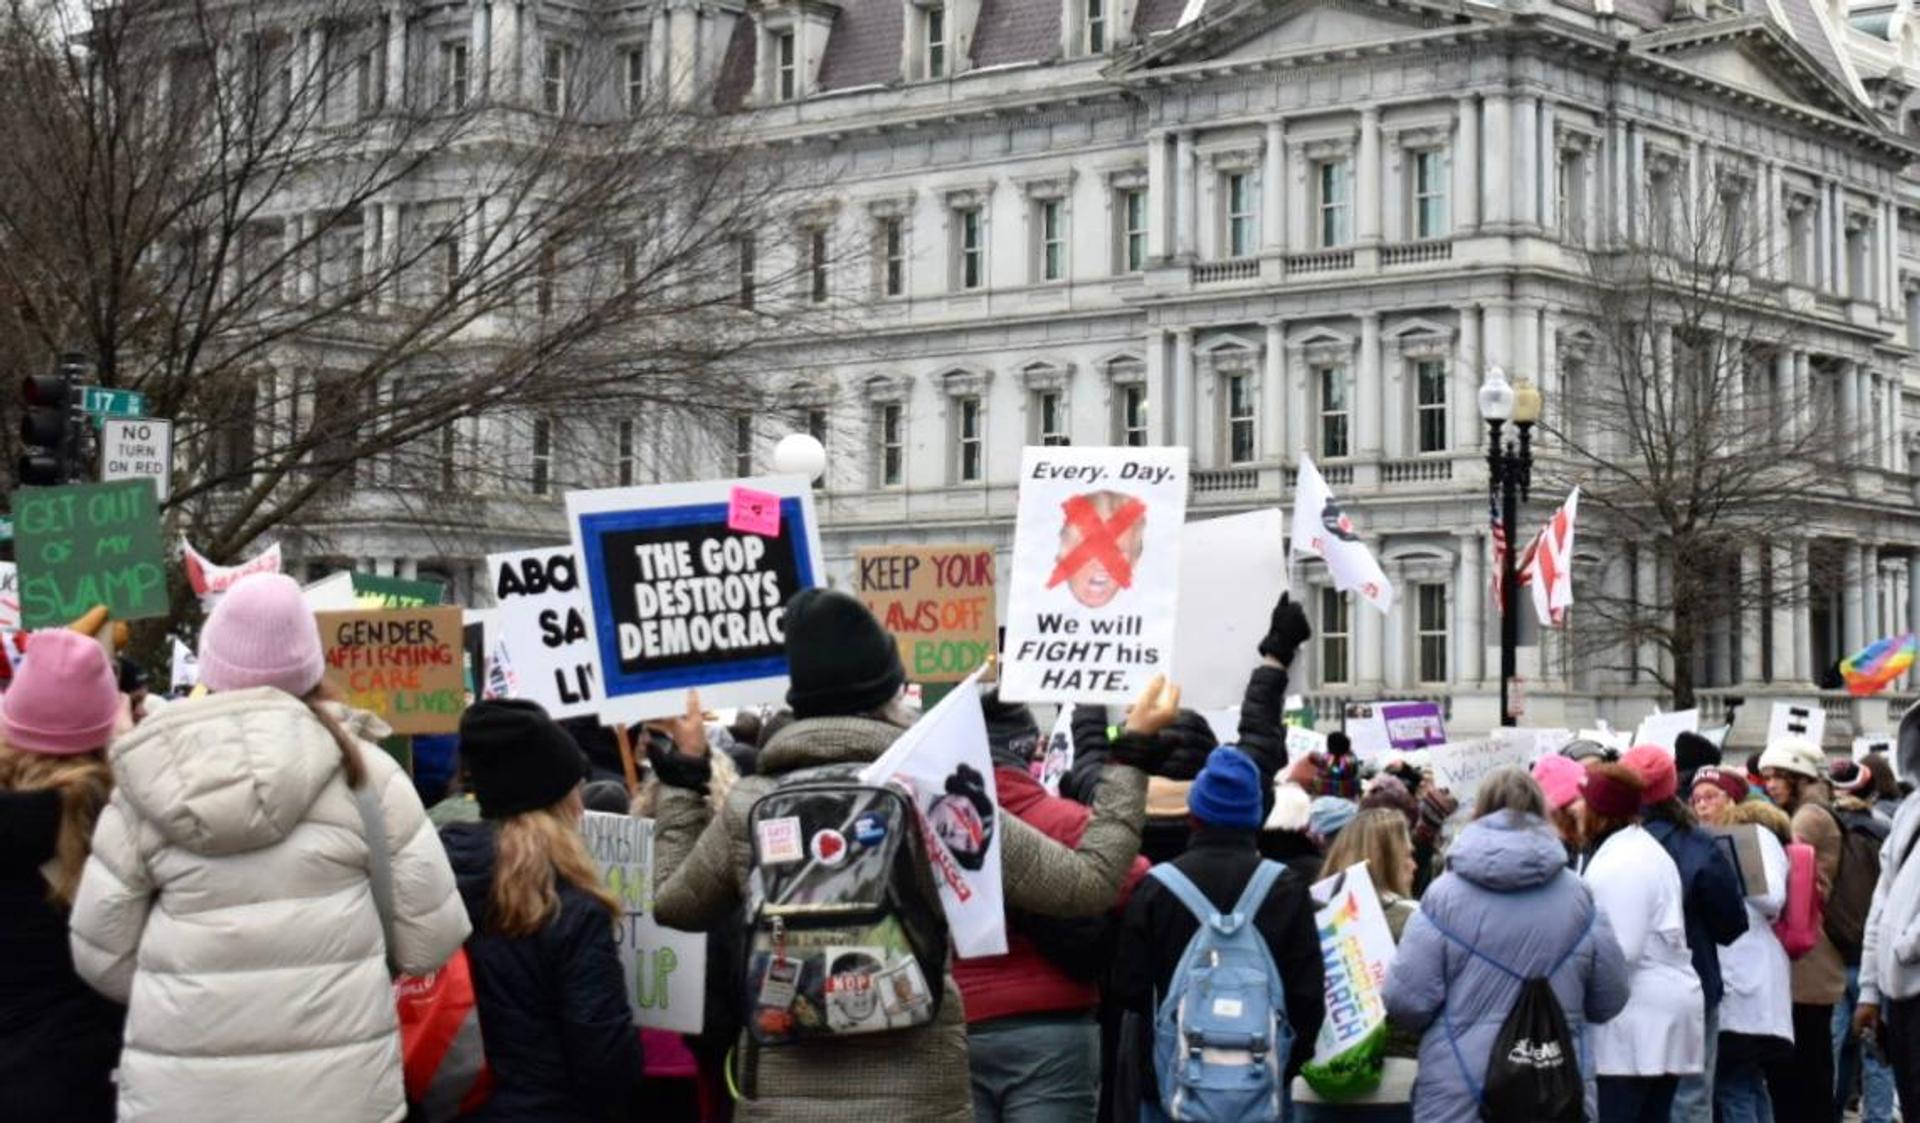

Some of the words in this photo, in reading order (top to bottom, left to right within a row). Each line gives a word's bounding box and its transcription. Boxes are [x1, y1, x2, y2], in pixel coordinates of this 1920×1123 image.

[94, 392, 115, 411] 17
[122, 425, 151, 440] NO
[118, 444, 155, 457] TURN
[108, 460, 129, 473] ON
[135, 461, 163, 474] RED
[1031, 461, 1109, 484] Every.
[1119, 461, 1175, 485] Day.
[20, 494, 77, 533] GET
[88, 486, 145, 526] OUT
[635, 541, 694, 580] THE
[700, 536, 766, 574] GOP
[861, 555, 920, 592] KEEP
[931, 552, 993, 588] YOUR
[23, 562, 161, 620] SWAMP
[497, 554, 579, 600] ABO
[634, 570, 782, 620] DESTROYS
[538, 606, 587, 648] SA
[868, 599, 939, 633] AWS
[941, 597, 987, 631] OFF
[1037, 612, 1079, 634] We
[1090, 614, 1142, 635] will
[337, 619, 439, 646] GENDER
[618, 607, 786, 662] DEMOCRAC
[326, 643, 453, 668] AFFIRMING
[1016, 641, 1112, 663] FIGHT
[1116, 642, 1159, 664] his
[350, 667, 422, 694] CARE
[1040, 668, 1130, 692] HATE.
[636, 947, 678, 1010] UP
[1322, 942, 1363, 1043] MARCH
